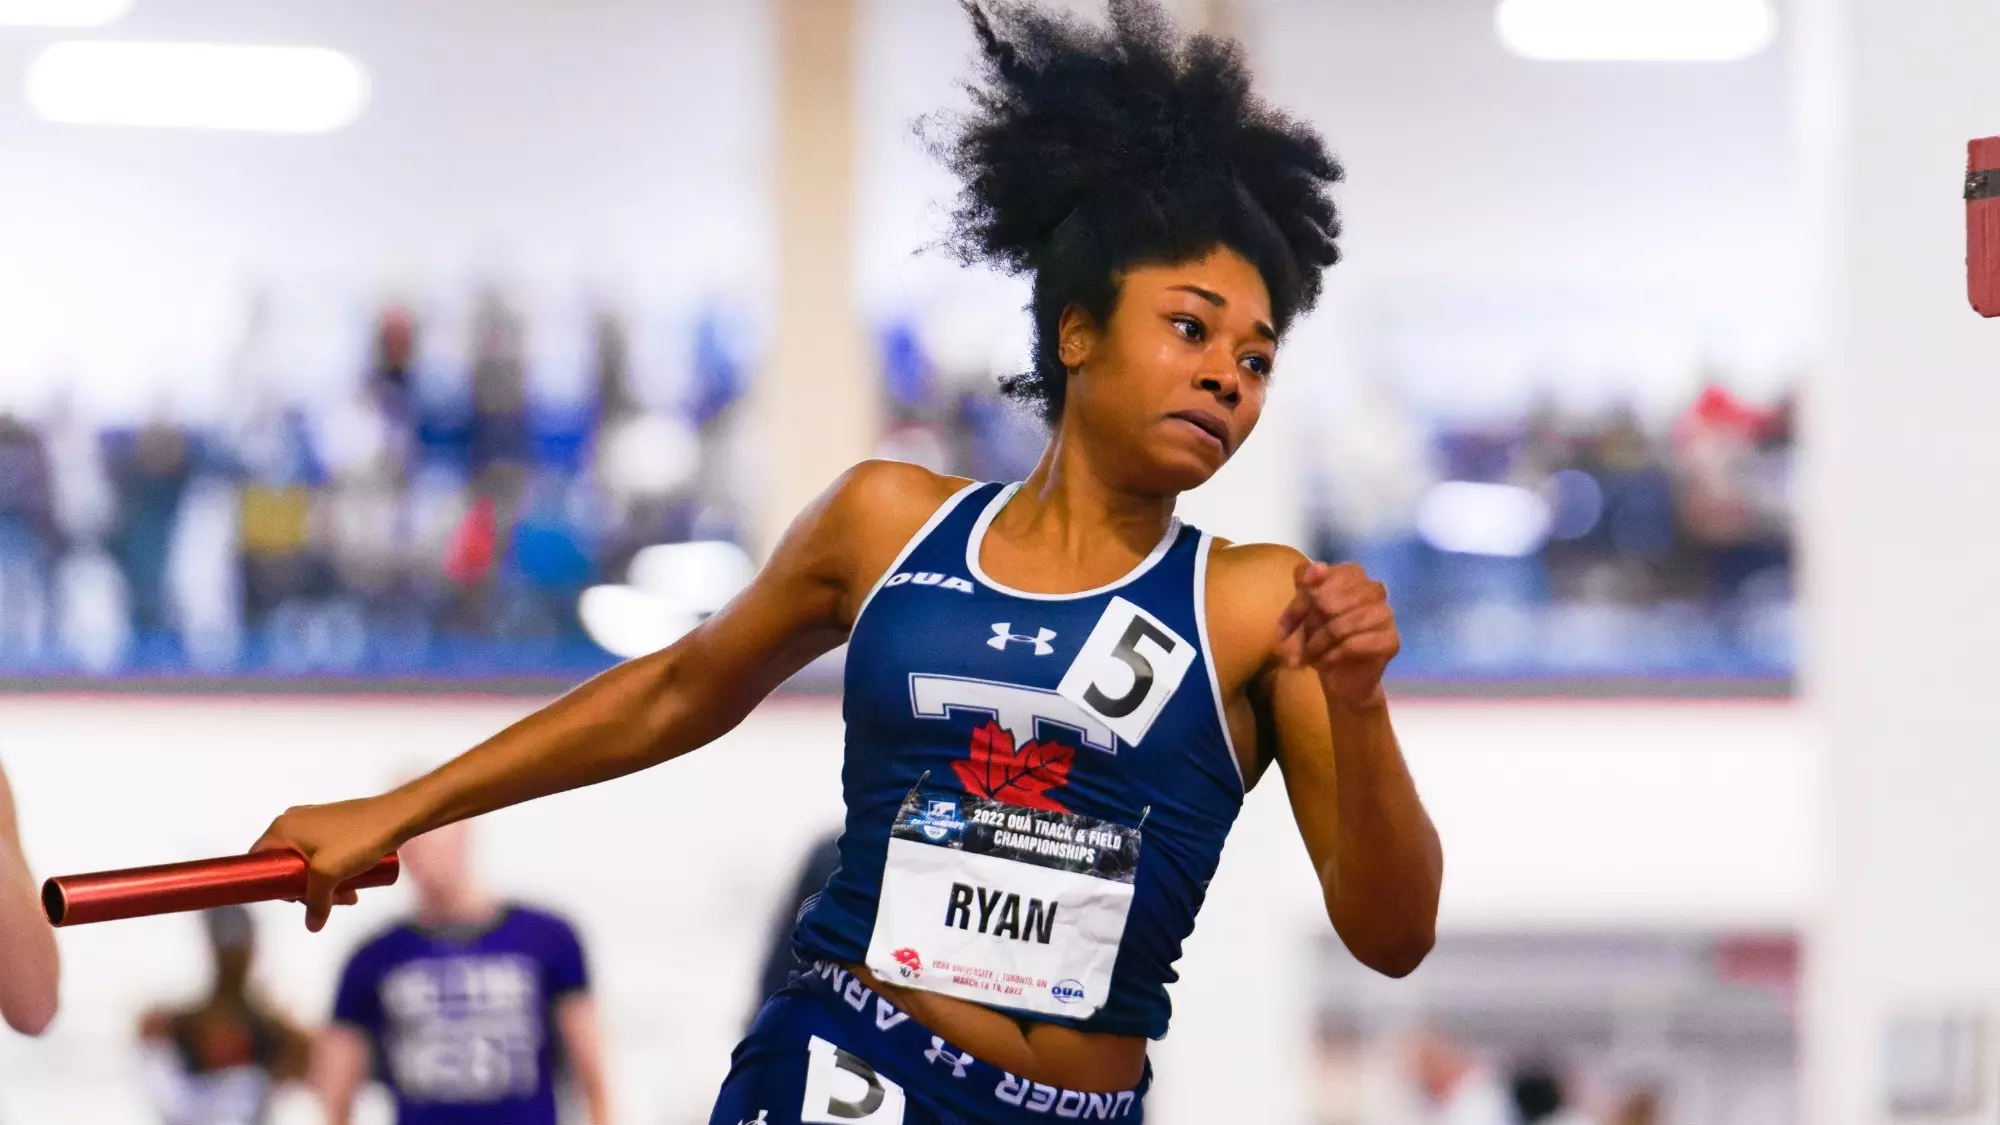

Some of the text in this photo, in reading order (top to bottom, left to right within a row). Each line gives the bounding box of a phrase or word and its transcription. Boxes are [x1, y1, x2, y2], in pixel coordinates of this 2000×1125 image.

[884, 572, 974, 595] OUA
[1083, 614, 1176, 718] 5
[973, 809, 1122, 850] 2022 OUA TRACK & FIELD
[993, 830, 1096, 863] CHAMPIONSHIPS
[944, 881, 1058, 945] RYAN
[951, 963, 993, 978] UNIVERSITY
[952, 975, 978, 988] MARCH
[1051, 986, 1084, 998] OUA
[995, 1071, 1135, 1119] UNDER
